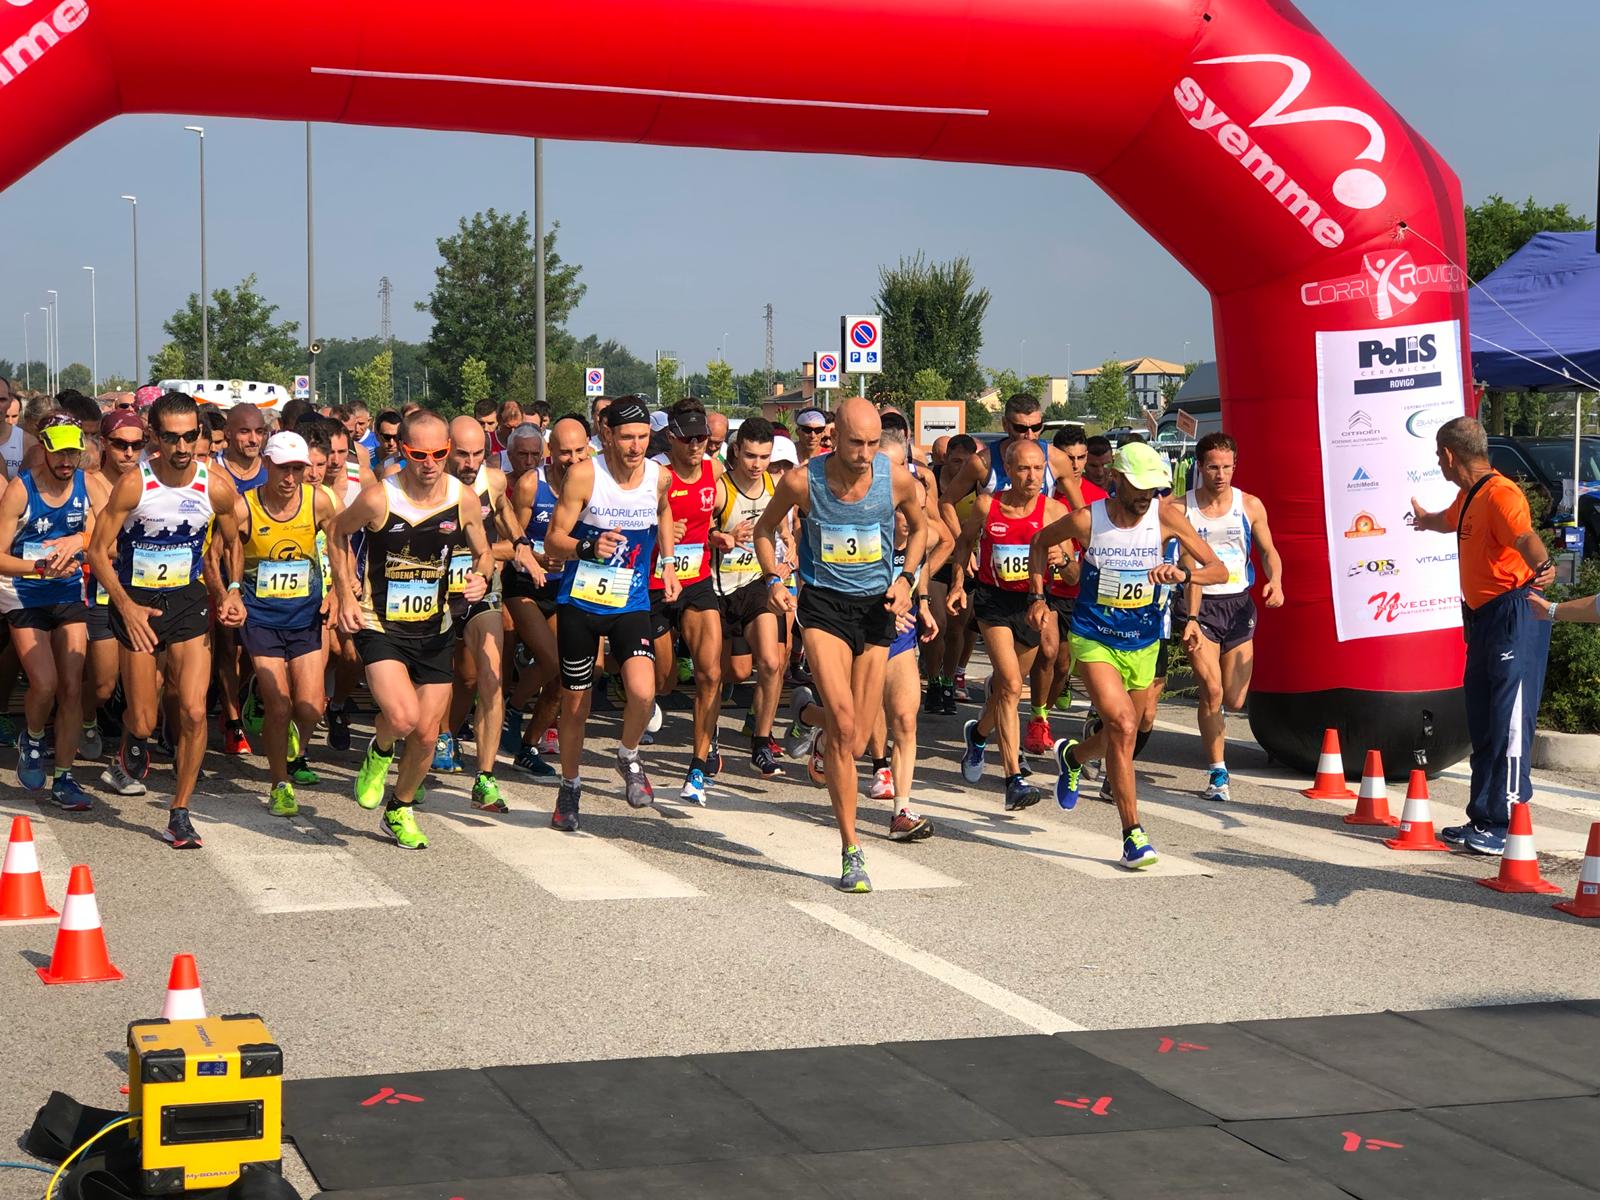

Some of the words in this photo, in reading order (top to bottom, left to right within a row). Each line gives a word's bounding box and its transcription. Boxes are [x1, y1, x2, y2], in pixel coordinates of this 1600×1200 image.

[1174, 77, 1344, 248] syemme
[1390, 378, 1415, 388] ROVIGO
[609, 519, 644, 527] FERRARA
[846, 538, 857, 556] 3
[737, 552, 753, 566] 49
[1003, 556, 1029, 573] 185
[1105, 559, 1143, 568] FERRARA
[157, 563, 168, 581] 2
[270, 573, 298, 590] 175
[596, 578, 608, 596] 5
[402, 595, 432, 613] 108
